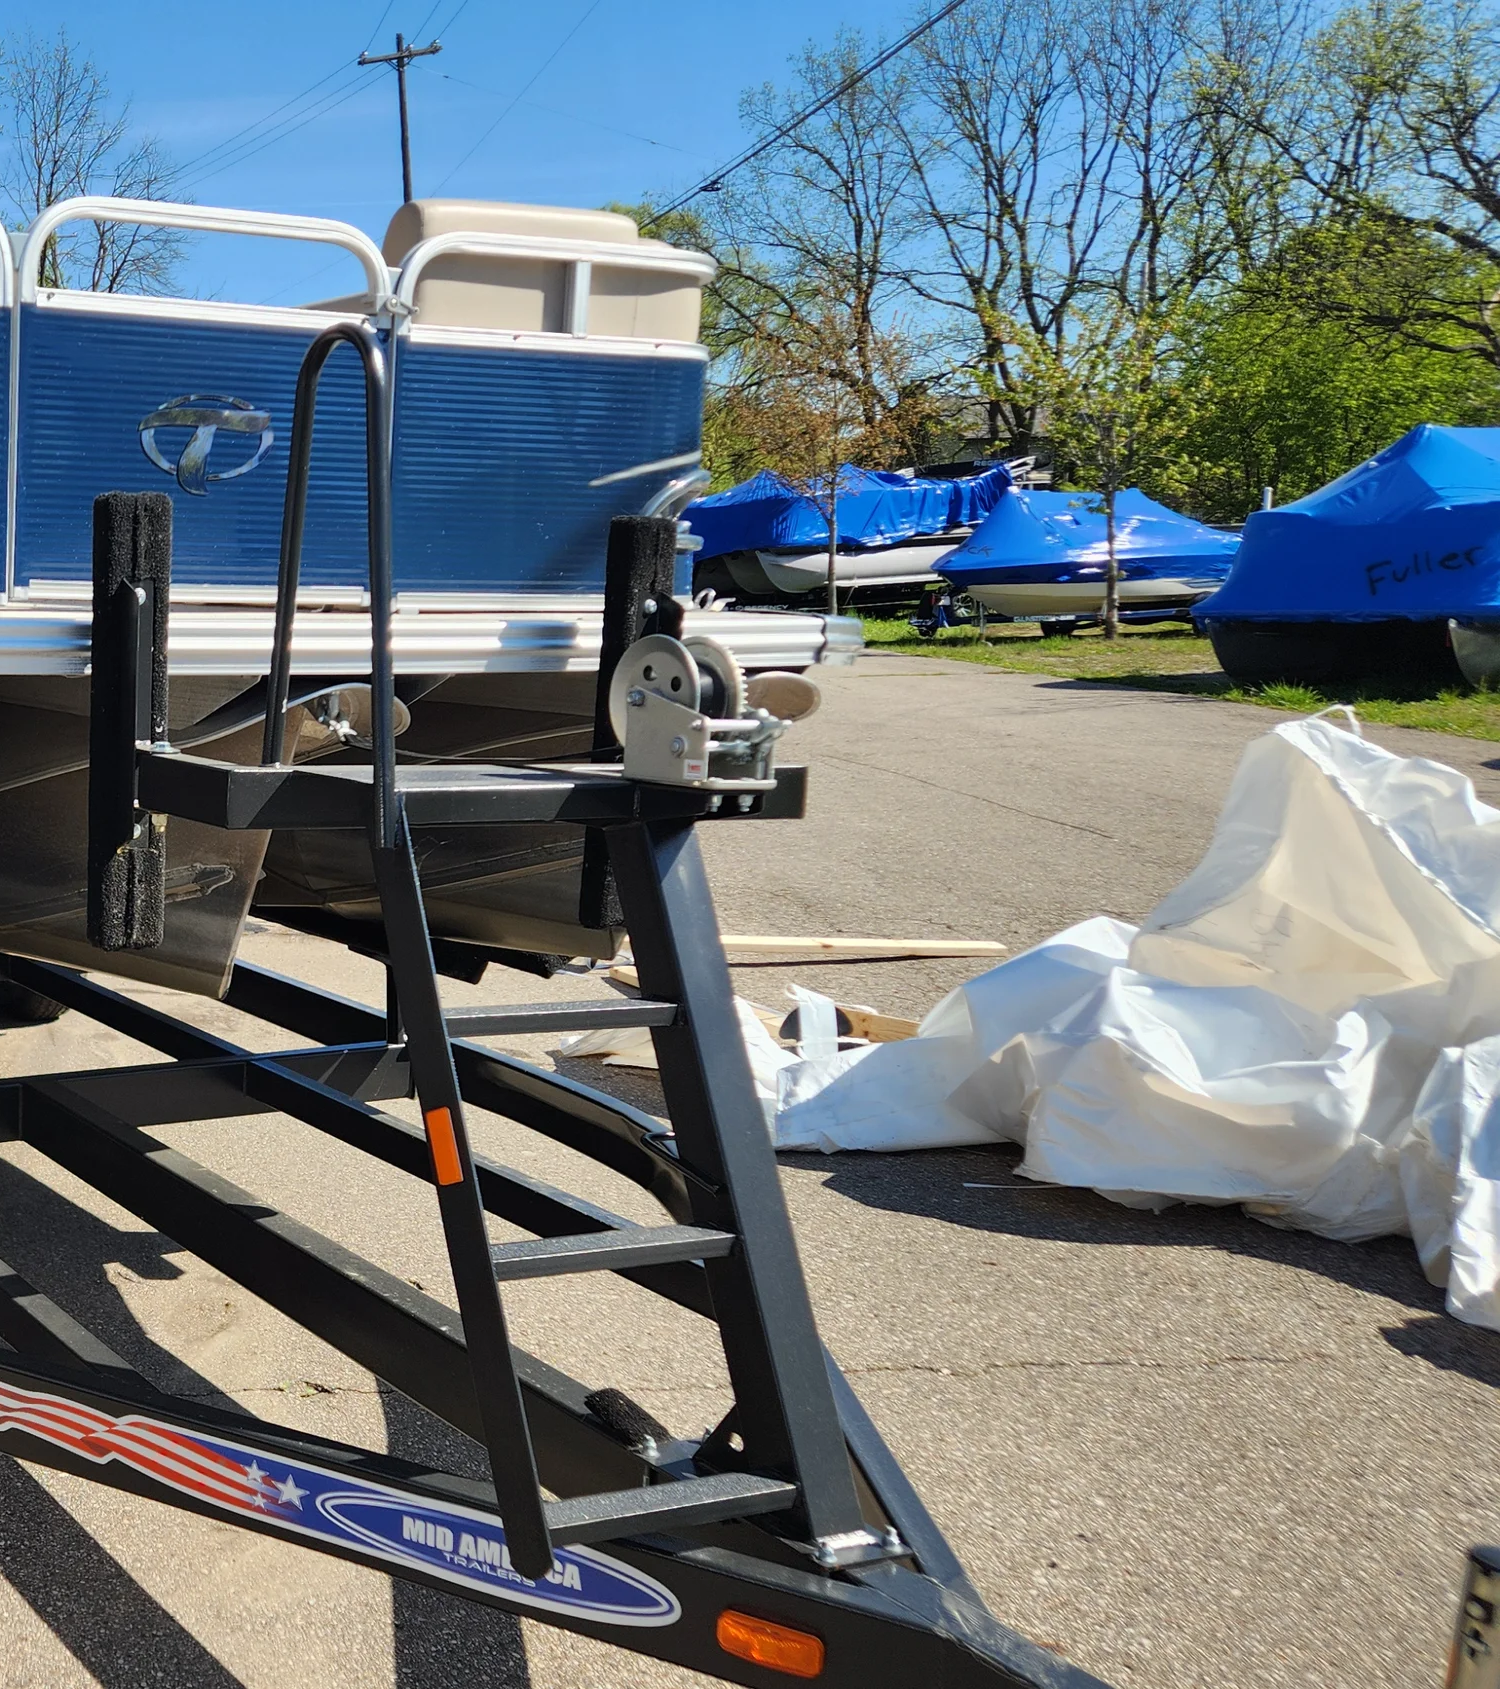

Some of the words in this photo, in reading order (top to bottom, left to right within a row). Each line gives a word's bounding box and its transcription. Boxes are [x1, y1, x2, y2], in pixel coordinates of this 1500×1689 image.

[1365, 545, 1486, 597] Fuller
[402, 1514, 454, 1553] MID
[459, 1531, 583, 1592] AMECA
[443, 1551, 537, 1588] TRAILERS
